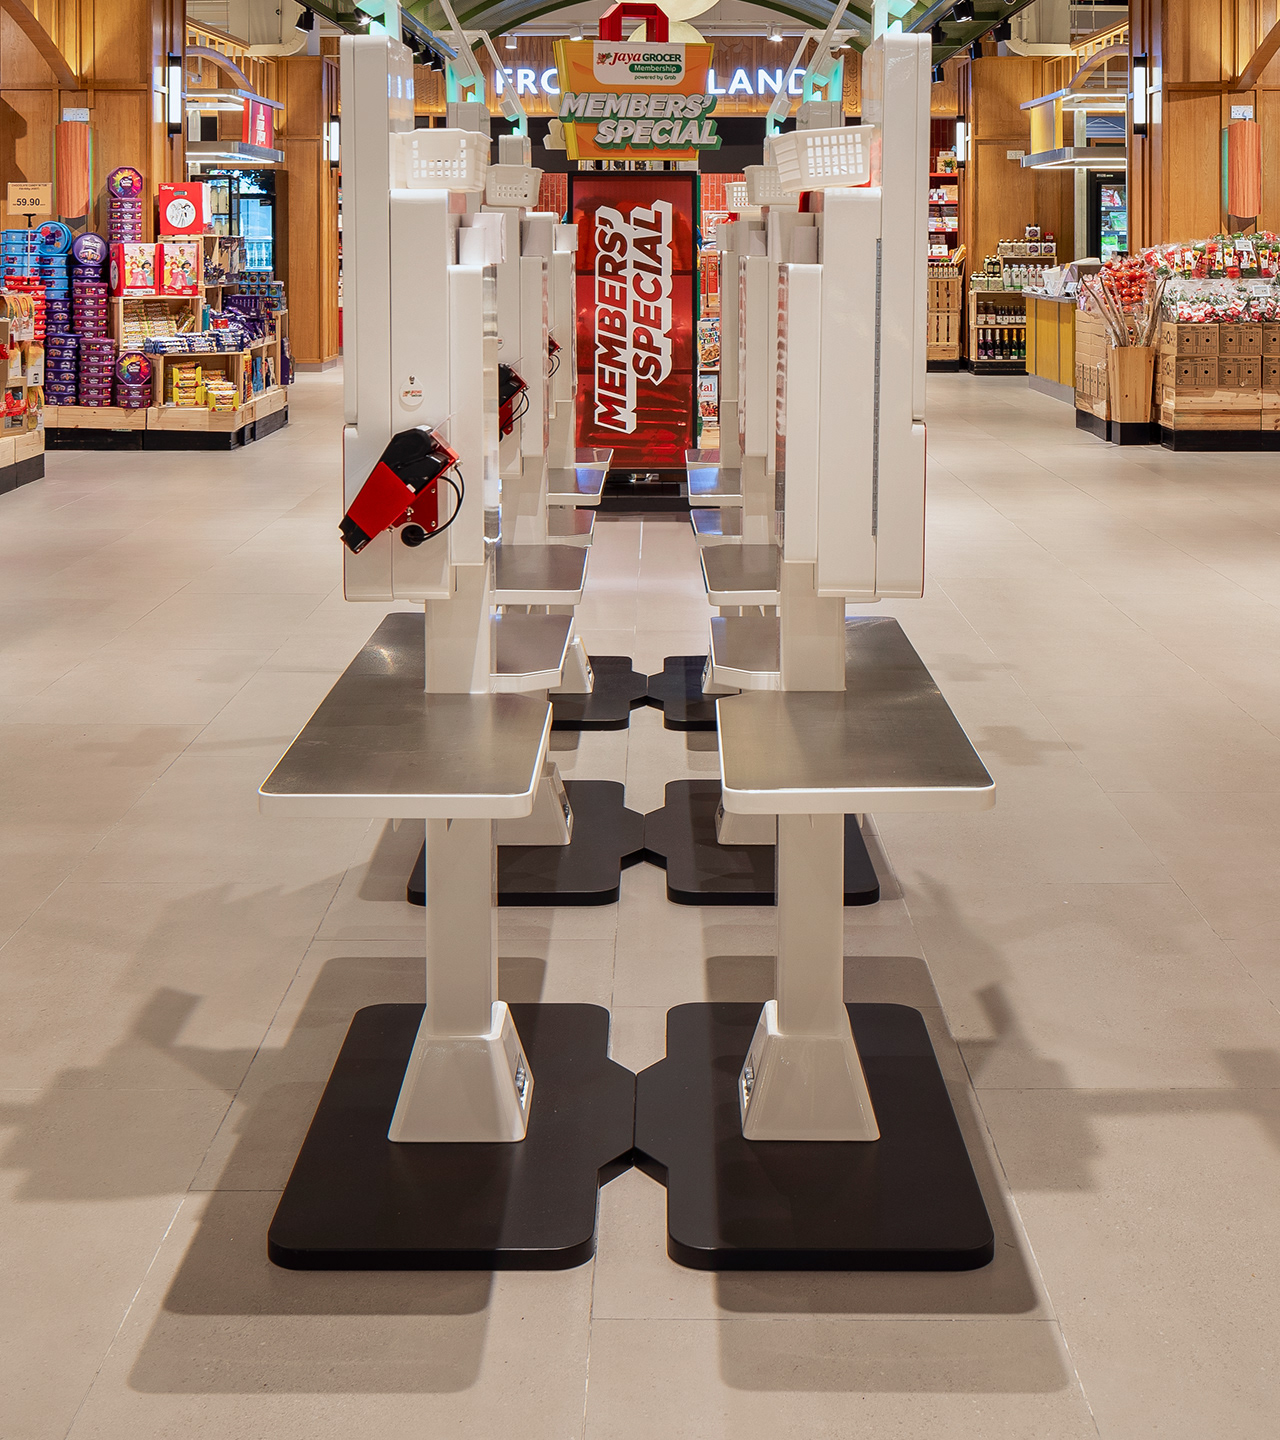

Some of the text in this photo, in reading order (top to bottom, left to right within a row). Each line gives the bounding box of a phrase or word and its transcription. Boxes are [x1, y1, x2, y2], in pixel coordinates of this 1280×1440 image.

[609, 52, 682, 66] Jaya GROCER
[634, 64, 676, 74] Membership
[495, 68, 807, 95] FRO LAND
[561, 92, 713, 118] MEMBERS'
[594, 120, 720, 144] SPECIAL
[17, 198, 40, 206] 59.90
[632, 211, 663, 380] SPECIAL
